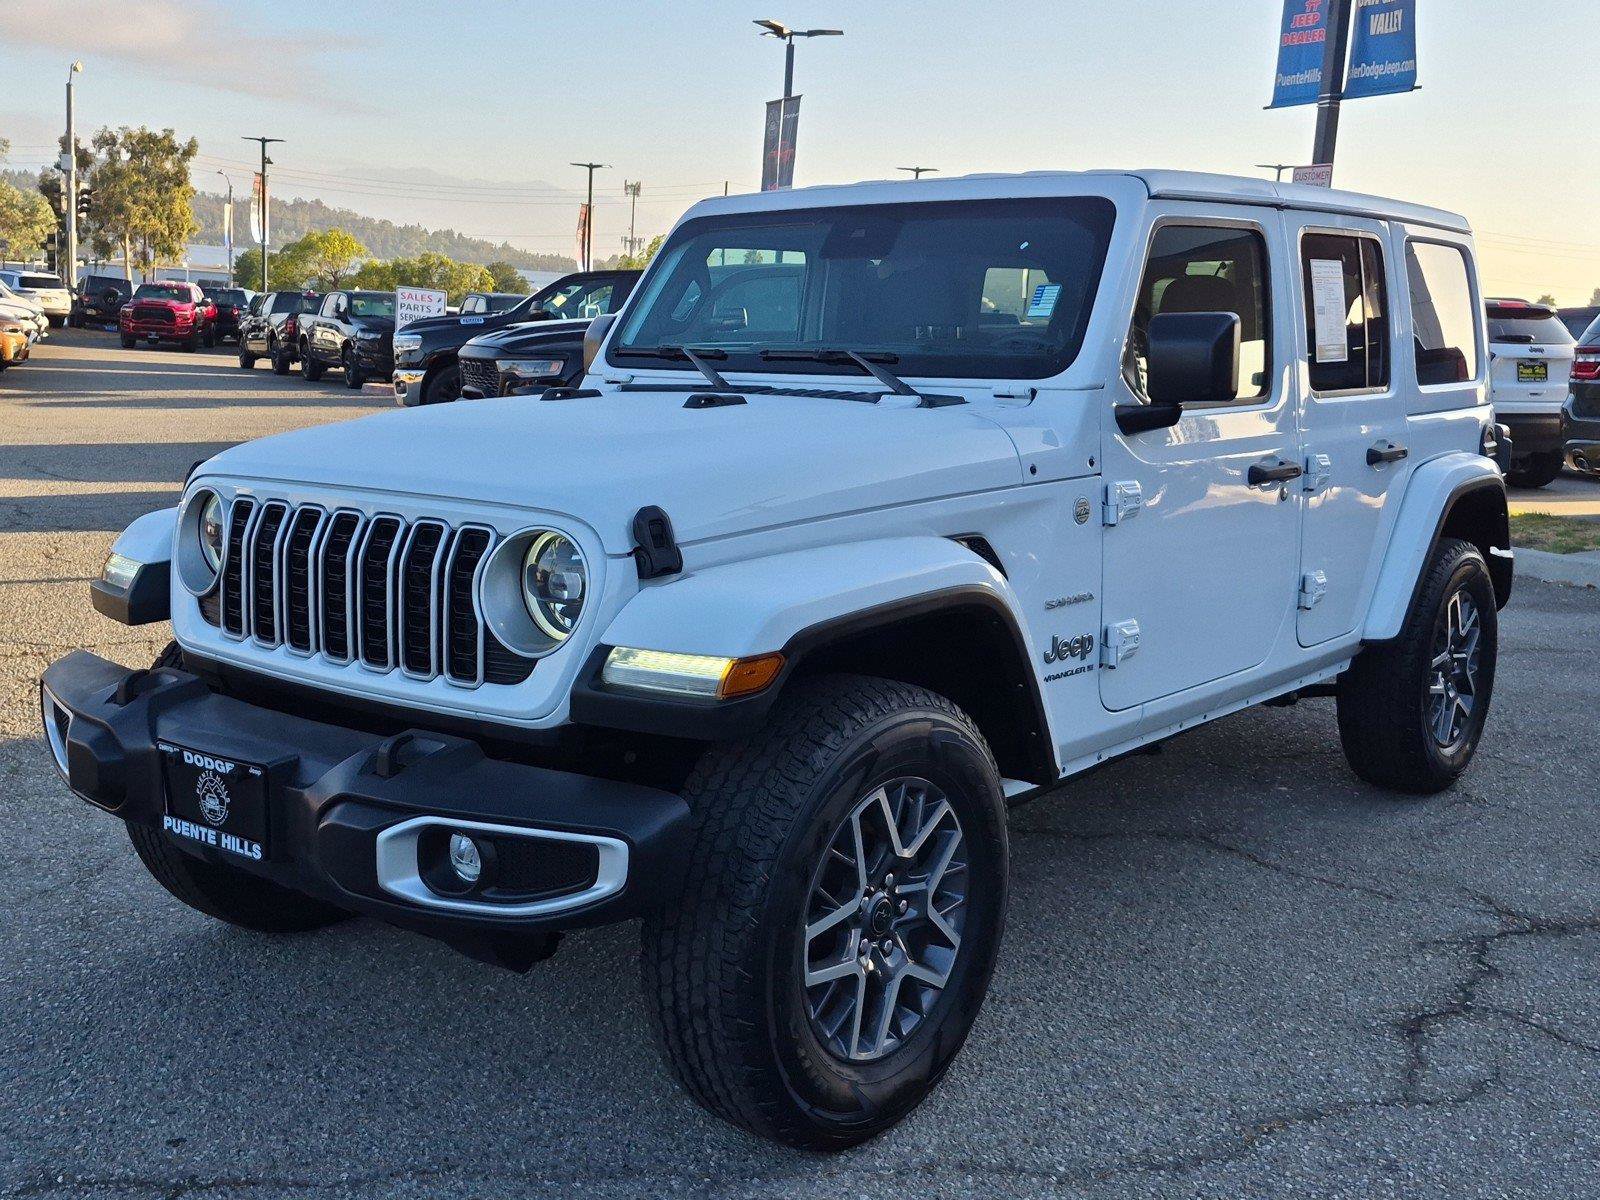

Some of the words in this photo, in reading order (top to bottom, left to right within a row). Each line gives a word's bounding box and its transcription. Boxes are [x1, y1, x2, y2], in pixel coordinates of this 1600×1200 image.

[1291, 13, 1320, 28] JEEP
[1369, 9, 1403, 36] VALLEY
[1282, 28, 1325, 46] DEALER
[1278, 69, 1321, 86] PuenteHills
[1295, 171, 1330, 182] CUSTOMER
[400, 292, 433, 303] SALES
[400, 302, 432, 313] PARTS
[1044, 592, 1095, 610] SAHARA
[1043, 633, 1094, 664] Jeep
[1043, 665, 1086, 683] WRANGLER
[163, 815, 217, 846] PUENTE
[221, 834, 263, 861] HILLS
